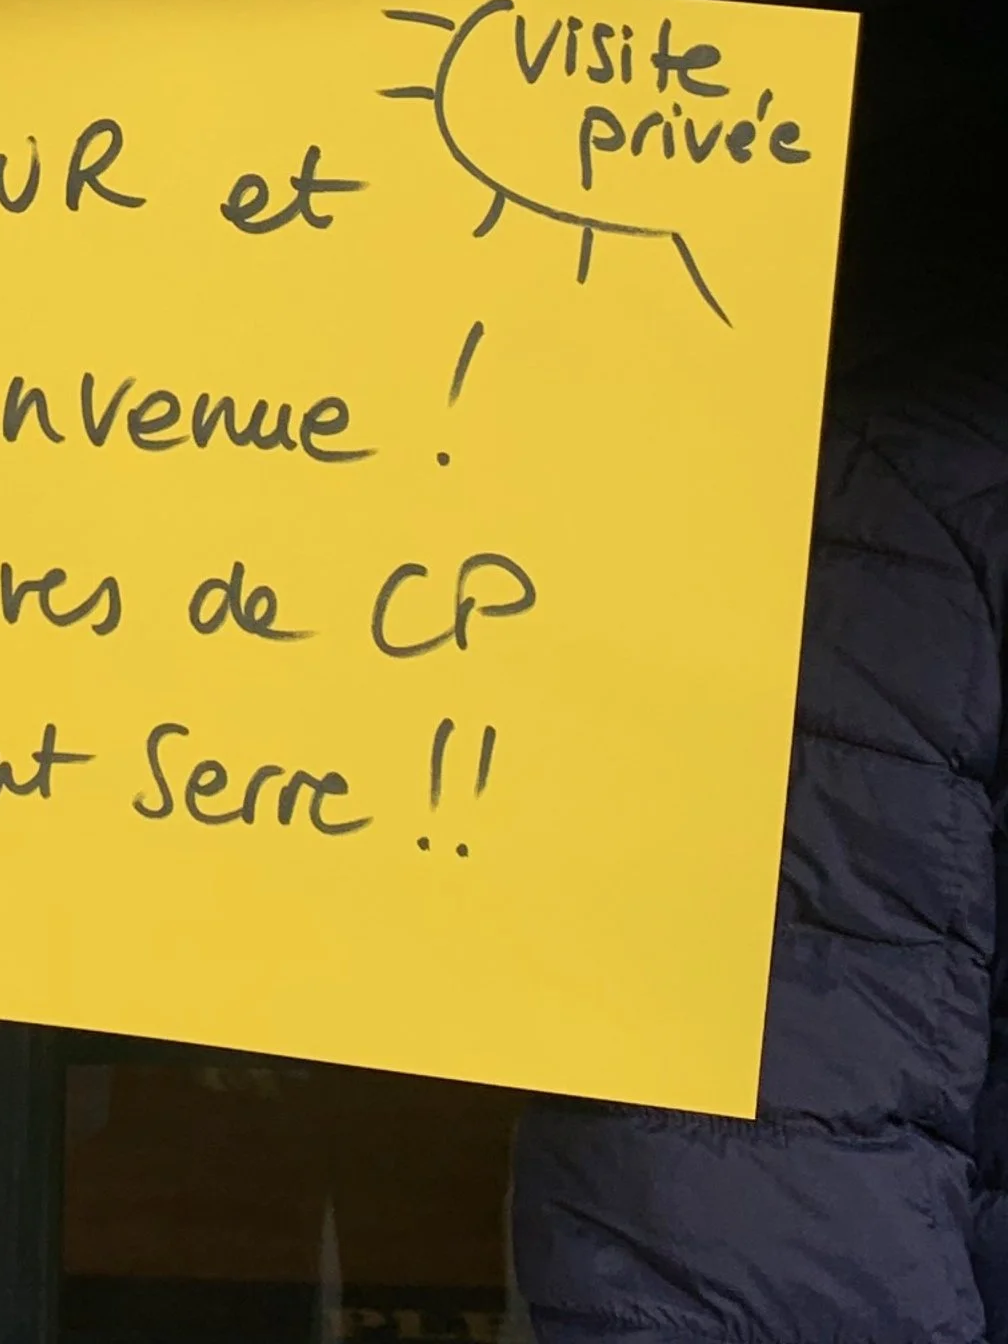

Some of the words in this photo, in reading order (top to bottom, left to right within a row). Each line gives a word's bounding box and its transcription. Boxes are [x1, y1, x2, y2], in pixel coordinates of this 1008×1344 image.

[220, 145, 365, 235] et
[579, 89, 812, 191] privée
[437, 321, 484, 467] !
[189, 562, 317, 642] de
[372, 553, 538, 658] CP
[132, 723, 374, 836] Serre
[417, 719, 497, 858] !!
